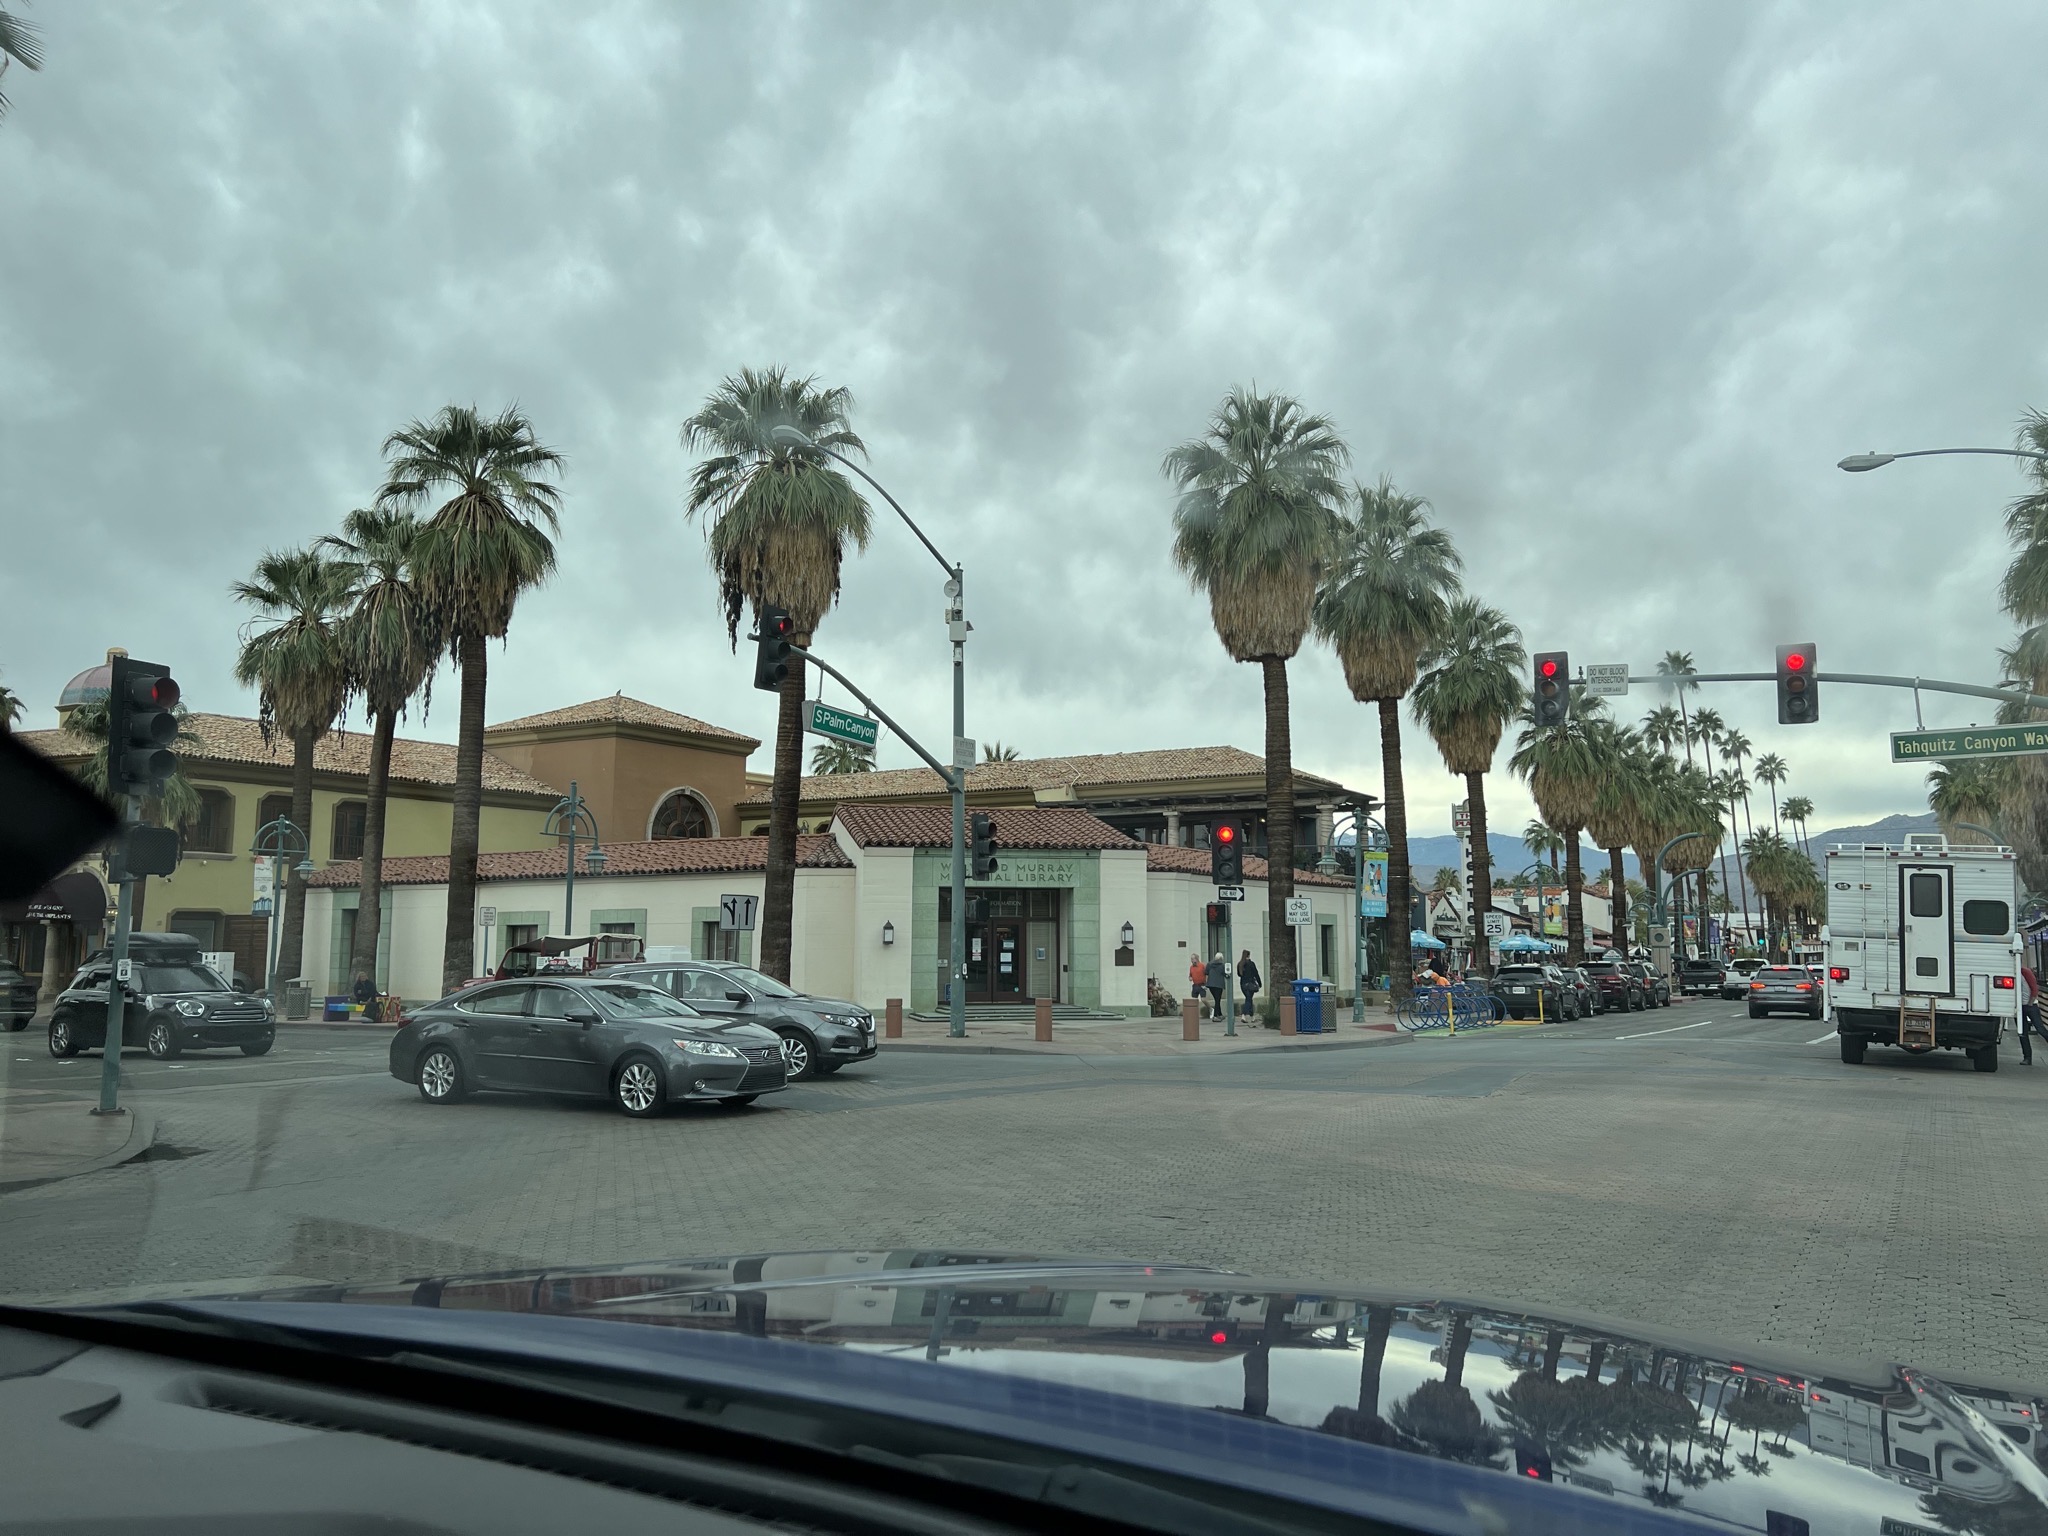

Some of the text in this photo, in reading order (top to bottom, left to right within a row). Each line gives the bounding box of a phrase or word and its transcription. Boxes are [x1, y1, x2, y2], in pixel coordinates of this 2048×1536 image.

[1590, 667, 1626, 676] DO NOT BLOCK
[1591, 676, 1625, 684] INTERSECTION
[815, 709, 876, 739] S Palm Canyon
[1897, 738, 1957, 756] Tahquitz
[1964, 736, 2016, 751] Canyon
[1016, 863, 1073, 873] MURRAY
[1017, 873, 1073, 882] LIBRARY
[1486, 924, 1502, 934] 25
